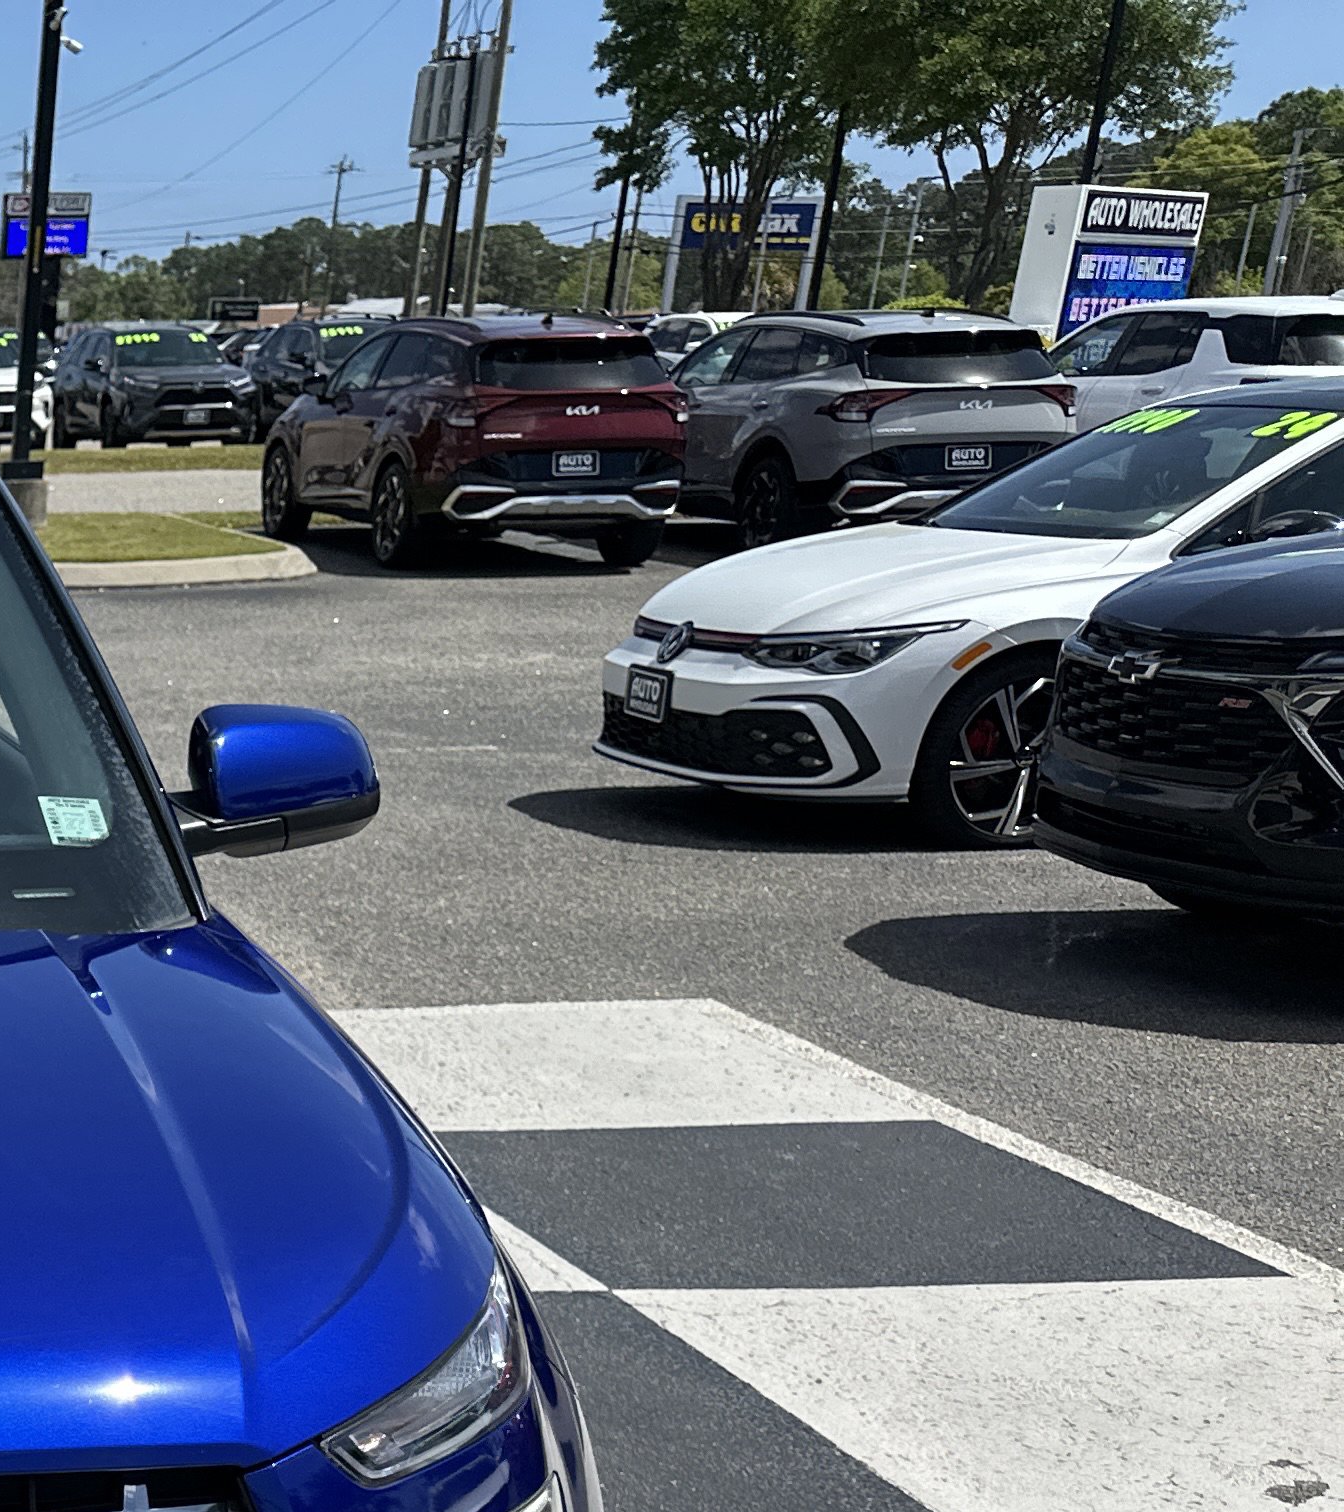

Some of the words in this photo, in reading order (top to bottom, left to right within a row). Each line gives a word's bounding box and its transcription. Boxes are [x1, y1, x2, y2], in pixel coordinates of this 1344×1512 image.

[1087, 197, 1128, 228] AUTO
[1128, 199, 1203, 232] WHOLESALE
[1077, 254, 1128, 280] BETTER
[951, 448, 985, 461] AUTO
